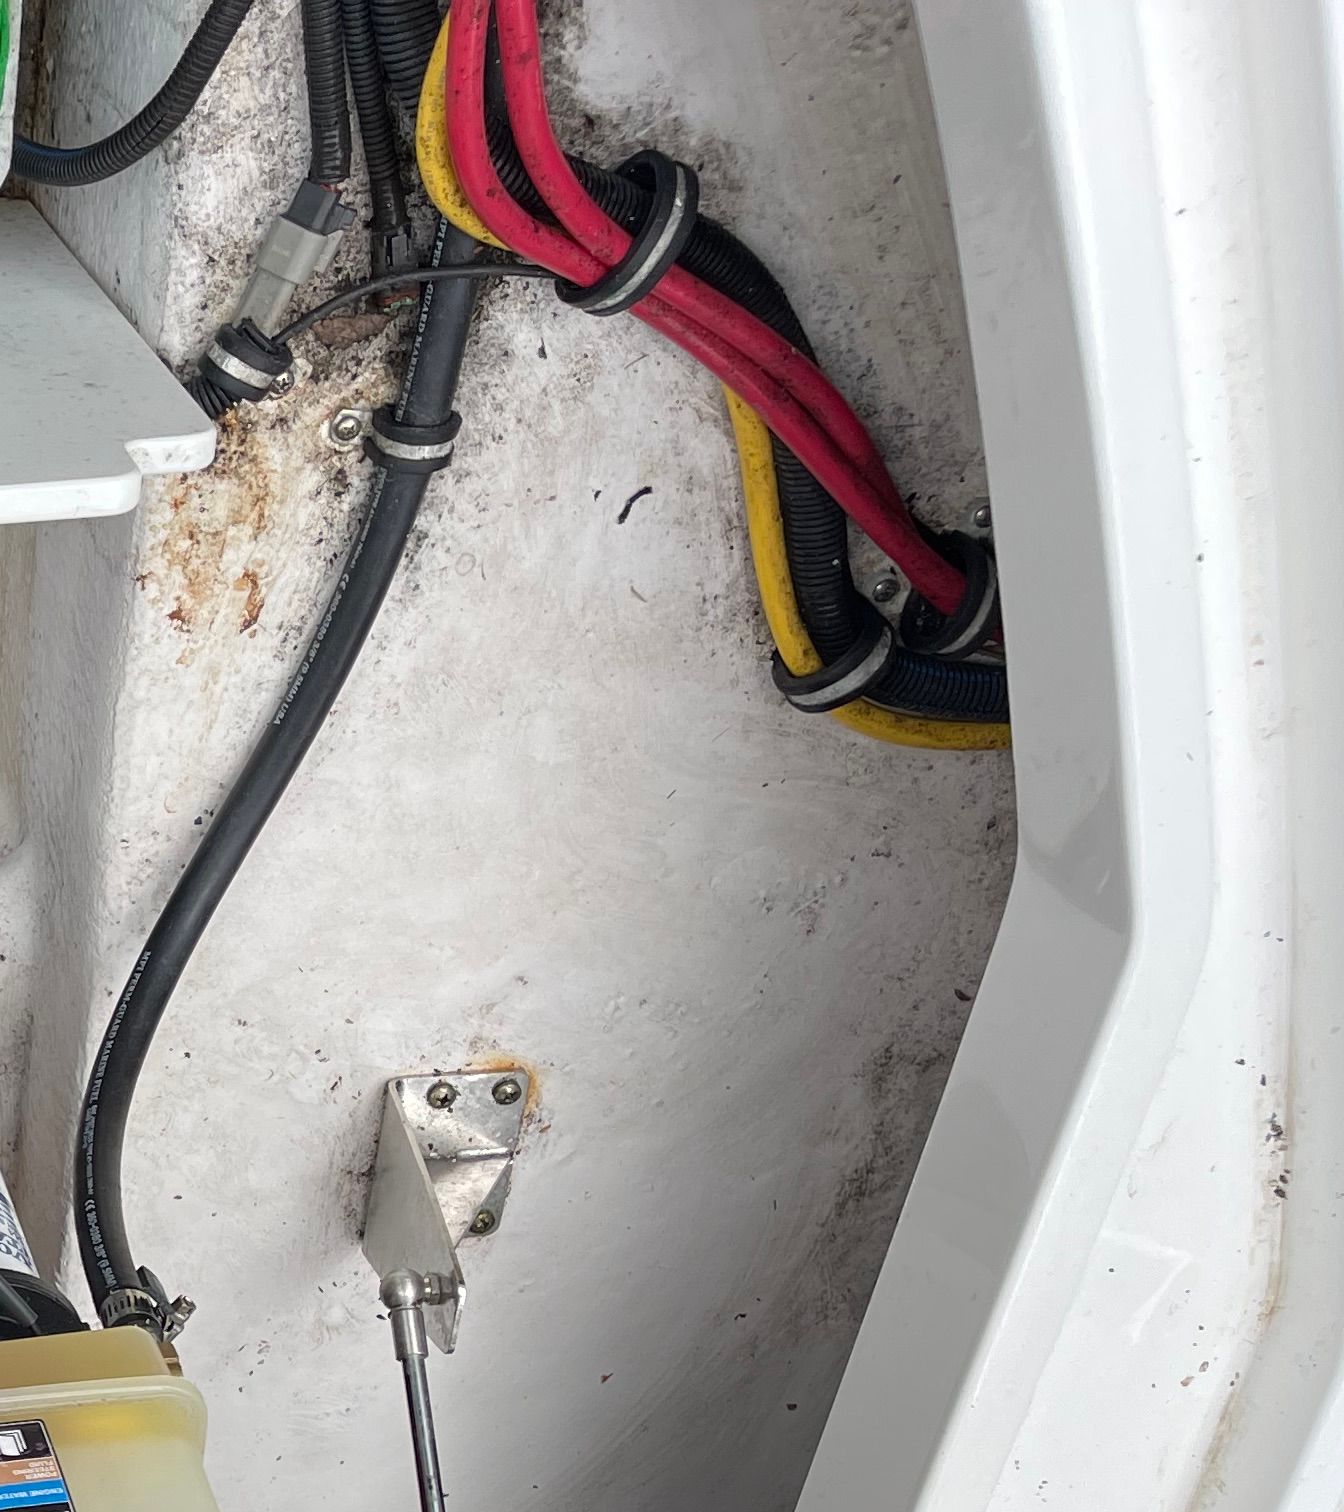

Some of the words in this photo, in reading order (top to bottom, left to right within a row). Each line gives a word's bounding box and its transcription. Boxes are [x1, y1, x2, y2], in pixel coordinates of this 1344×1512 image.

[411, 240, 447, 333] PER-GUARD
[272, 701, 289, 727] USA
[29, 1487, 63, 1496] ENGINE
